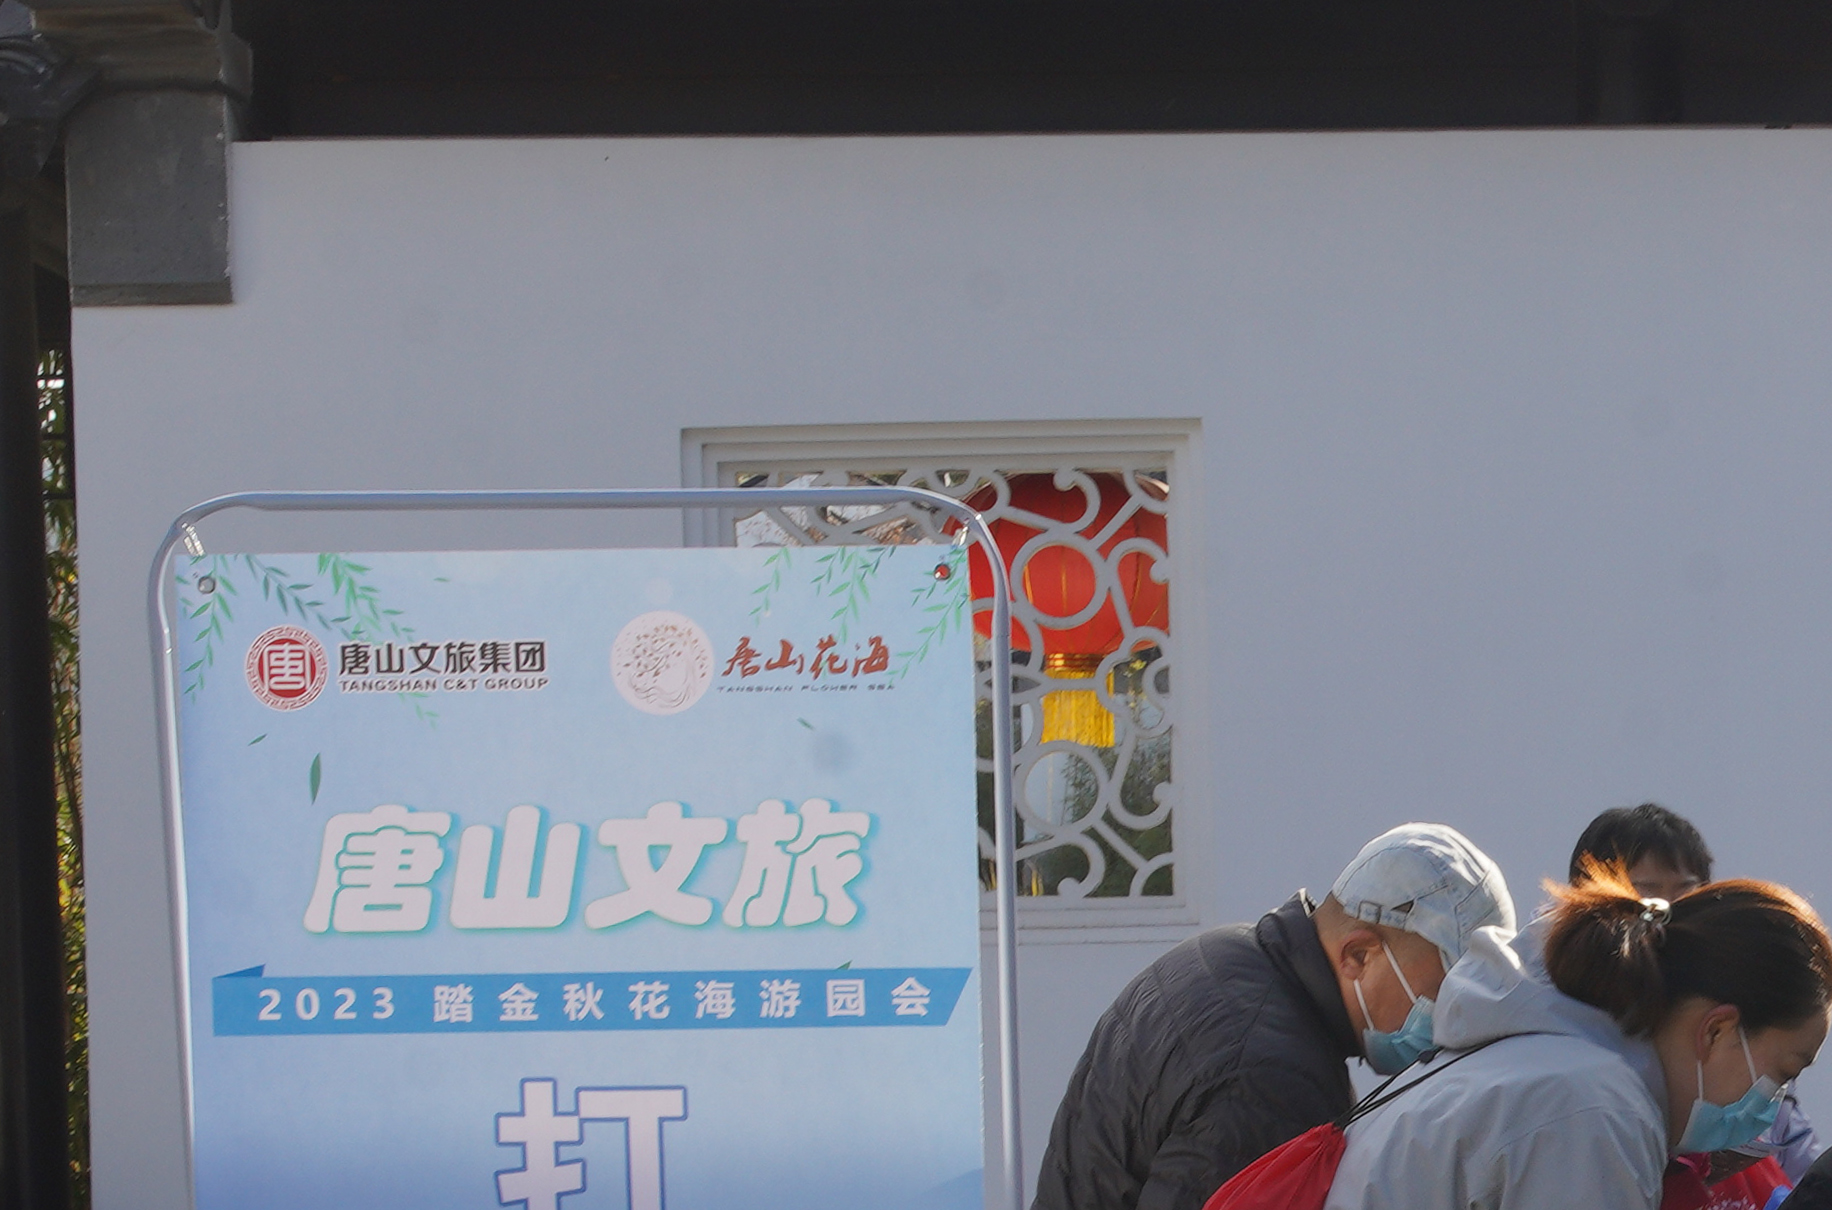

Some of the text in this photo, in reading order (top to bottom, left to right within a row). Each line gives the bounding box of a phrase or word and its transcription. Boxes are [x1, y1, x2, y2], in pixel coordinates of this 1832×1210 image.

[338, 640, 546, 675] 唐山文旅集团
[721, 635, 889, 679] 唐山花海
[338, 675, 549, 693] TANGSHAN C&T GROUP
[303, 798, 874, 934] 唐山文旅
[257, 976, 932, 1024] 2023 踏金秋花海游园会
